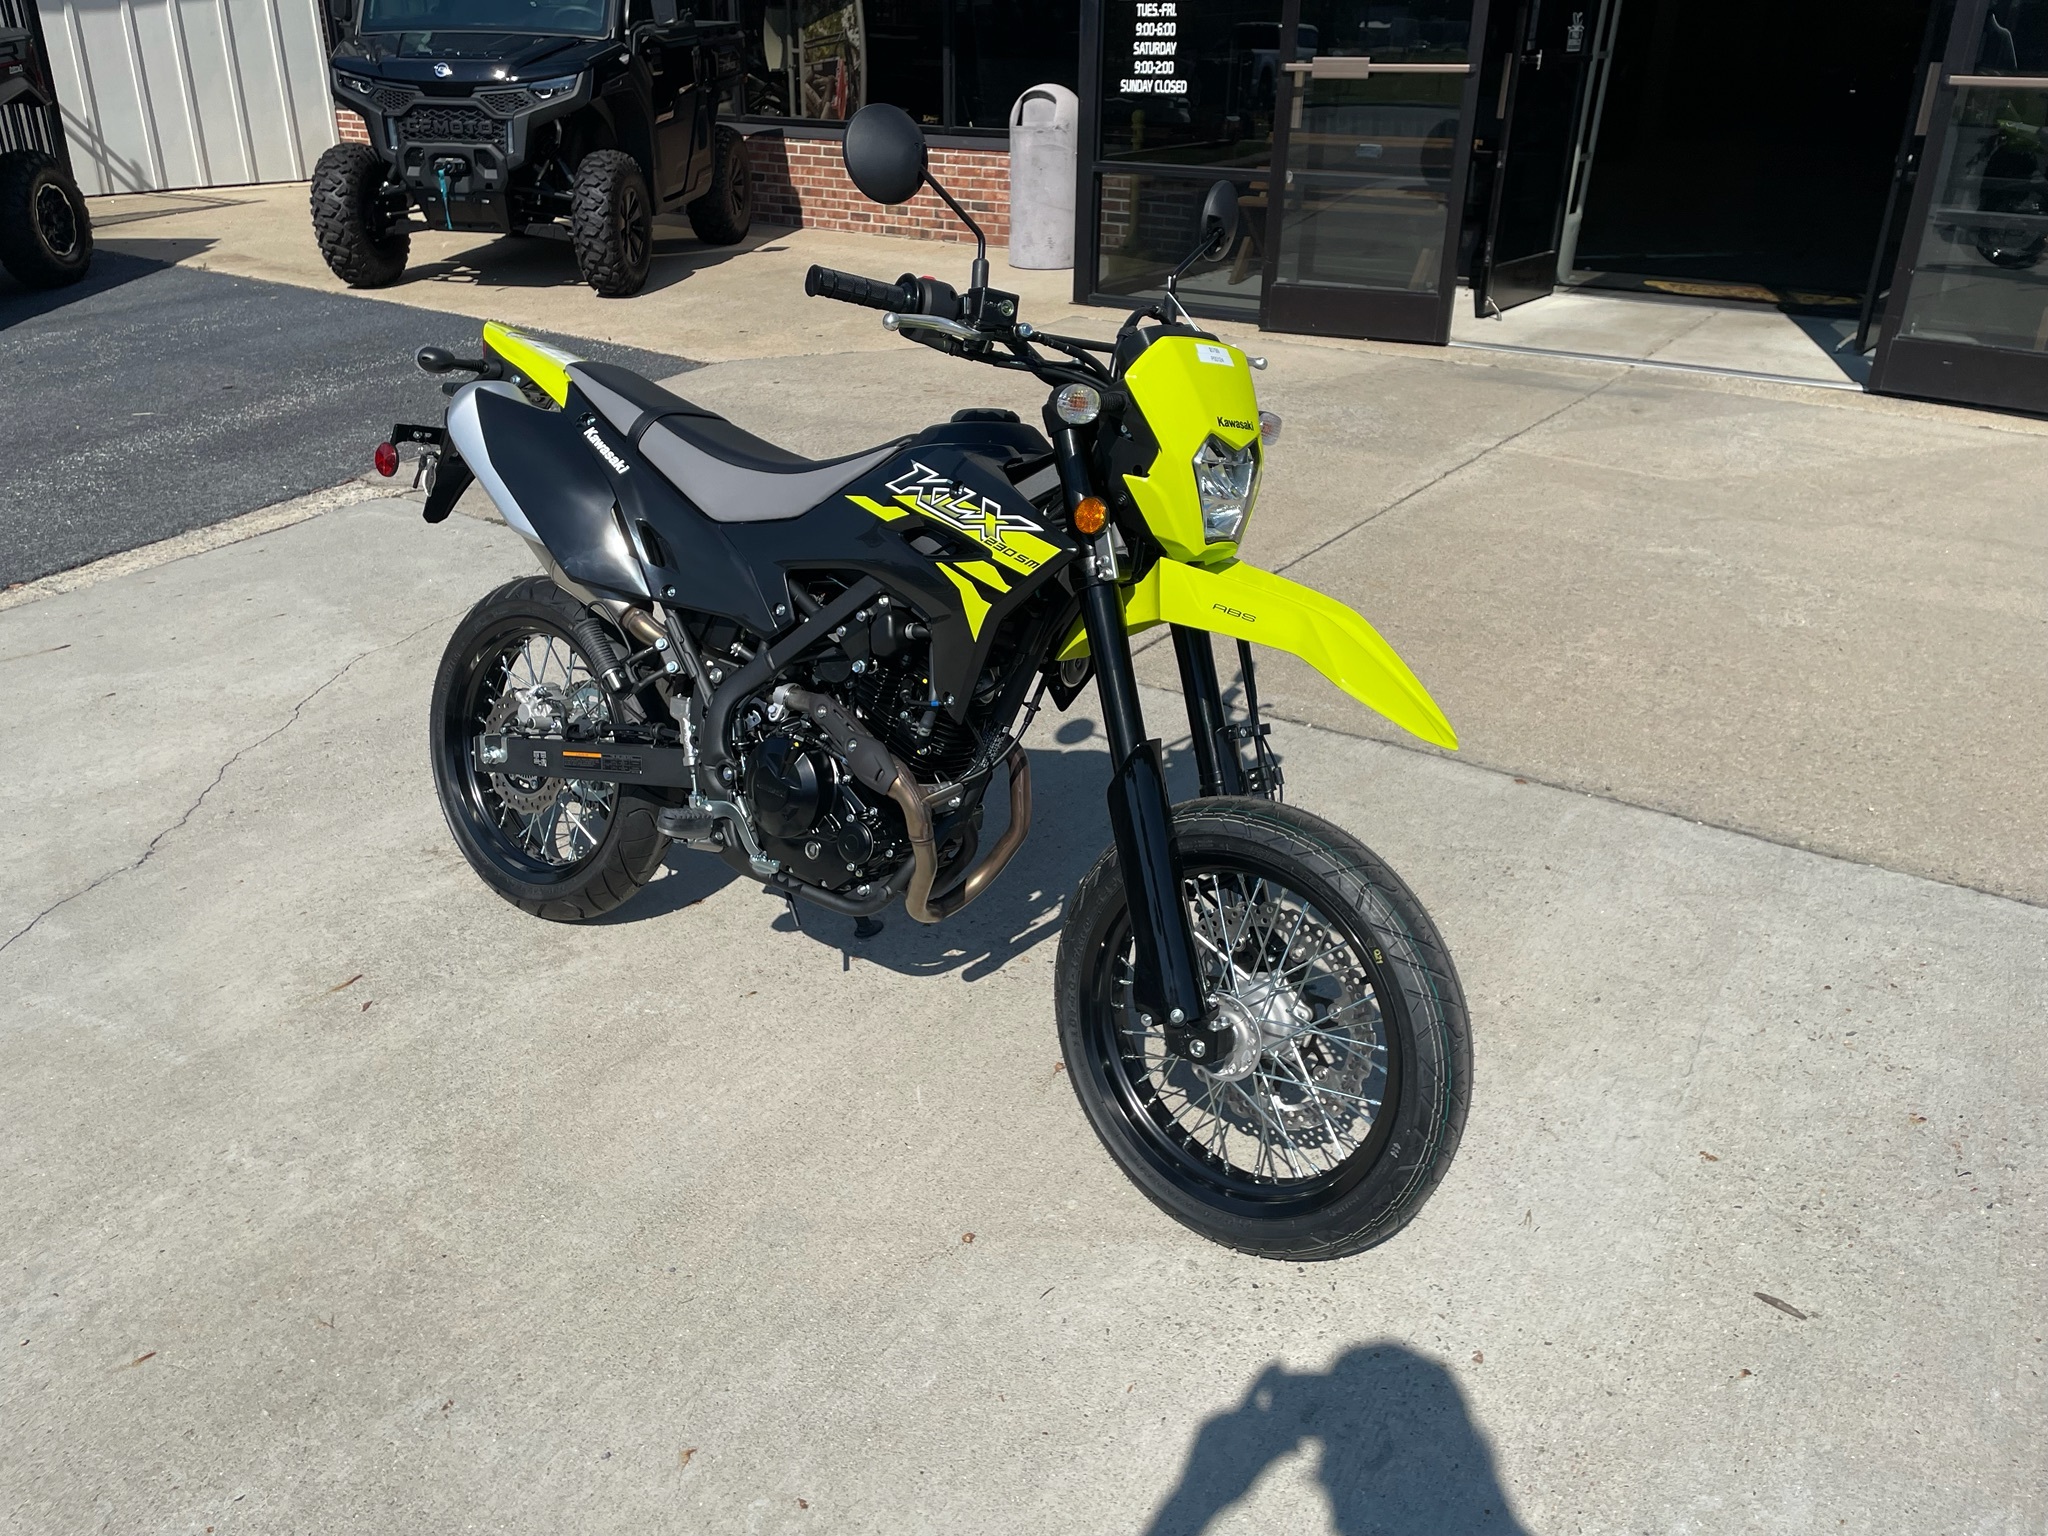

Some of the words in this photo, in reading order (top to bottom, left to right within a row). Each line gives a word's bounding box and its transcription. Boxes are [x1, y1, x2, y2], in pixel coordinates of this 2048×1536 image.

[1135, 22, 1176, 36] 9:00-6:00
[1133, 41, 1177, 55] SATURDAY
[1134, 60, 1174, 74] 9:00-2:00
[1120, 79, 1153, 93] SUNDAY
[1154, 80, 1187, 94] CLOSED
[406, 117, 493, 134] CFMOTO
[1217, 416, 1254, 431] Kawasaki
[583, 426, 631, 475] Kawasaki
[885, 459, 1044, 544] KLX
[1213, 603, 1256, 622] ABS
